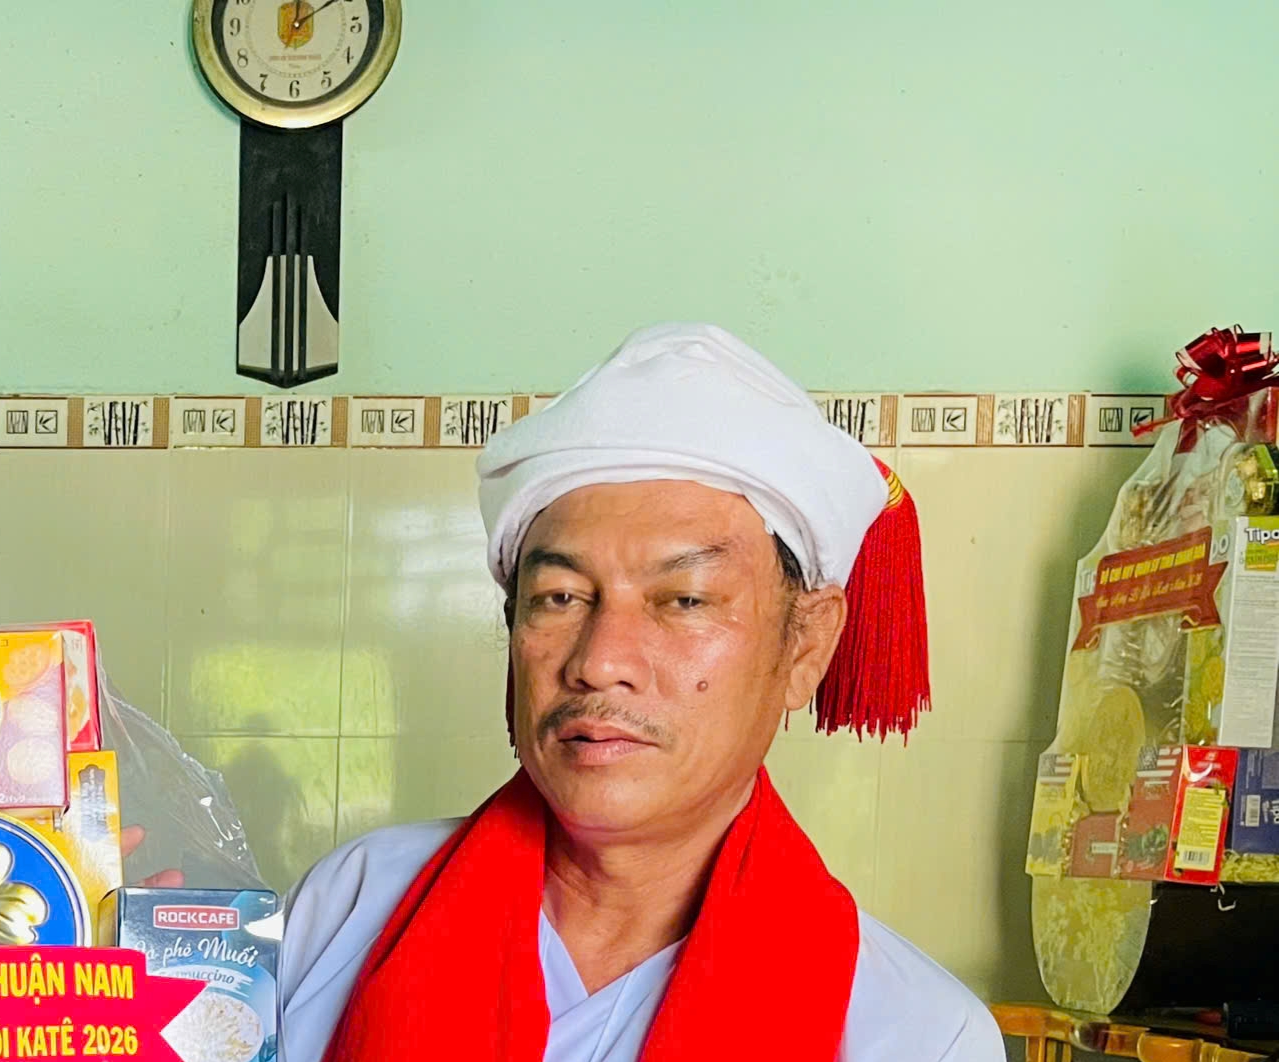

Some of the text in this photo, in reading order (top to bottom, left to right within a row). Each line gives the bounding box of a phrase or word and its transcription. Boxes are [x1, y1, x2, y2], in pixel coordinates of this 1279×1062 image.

[229, 17, 241, 37] 9
[237, 48, 249, 68] 8
[342, 45, 354, 64] 4
[259, 73, 268, 92] 7
[289, 79, 300, 98] 6
[320, 70, 332, 89] 5
[158, 911, 235, 925] ROCKCAFE
[163, 936, 193, 967] phê
[197, 936, 259, 968] Muối
[74, 963, 134, 999] NAM
[16, 1017, 75, 1057] KATÊ
[82, 1024, 138, 1055] 2026
